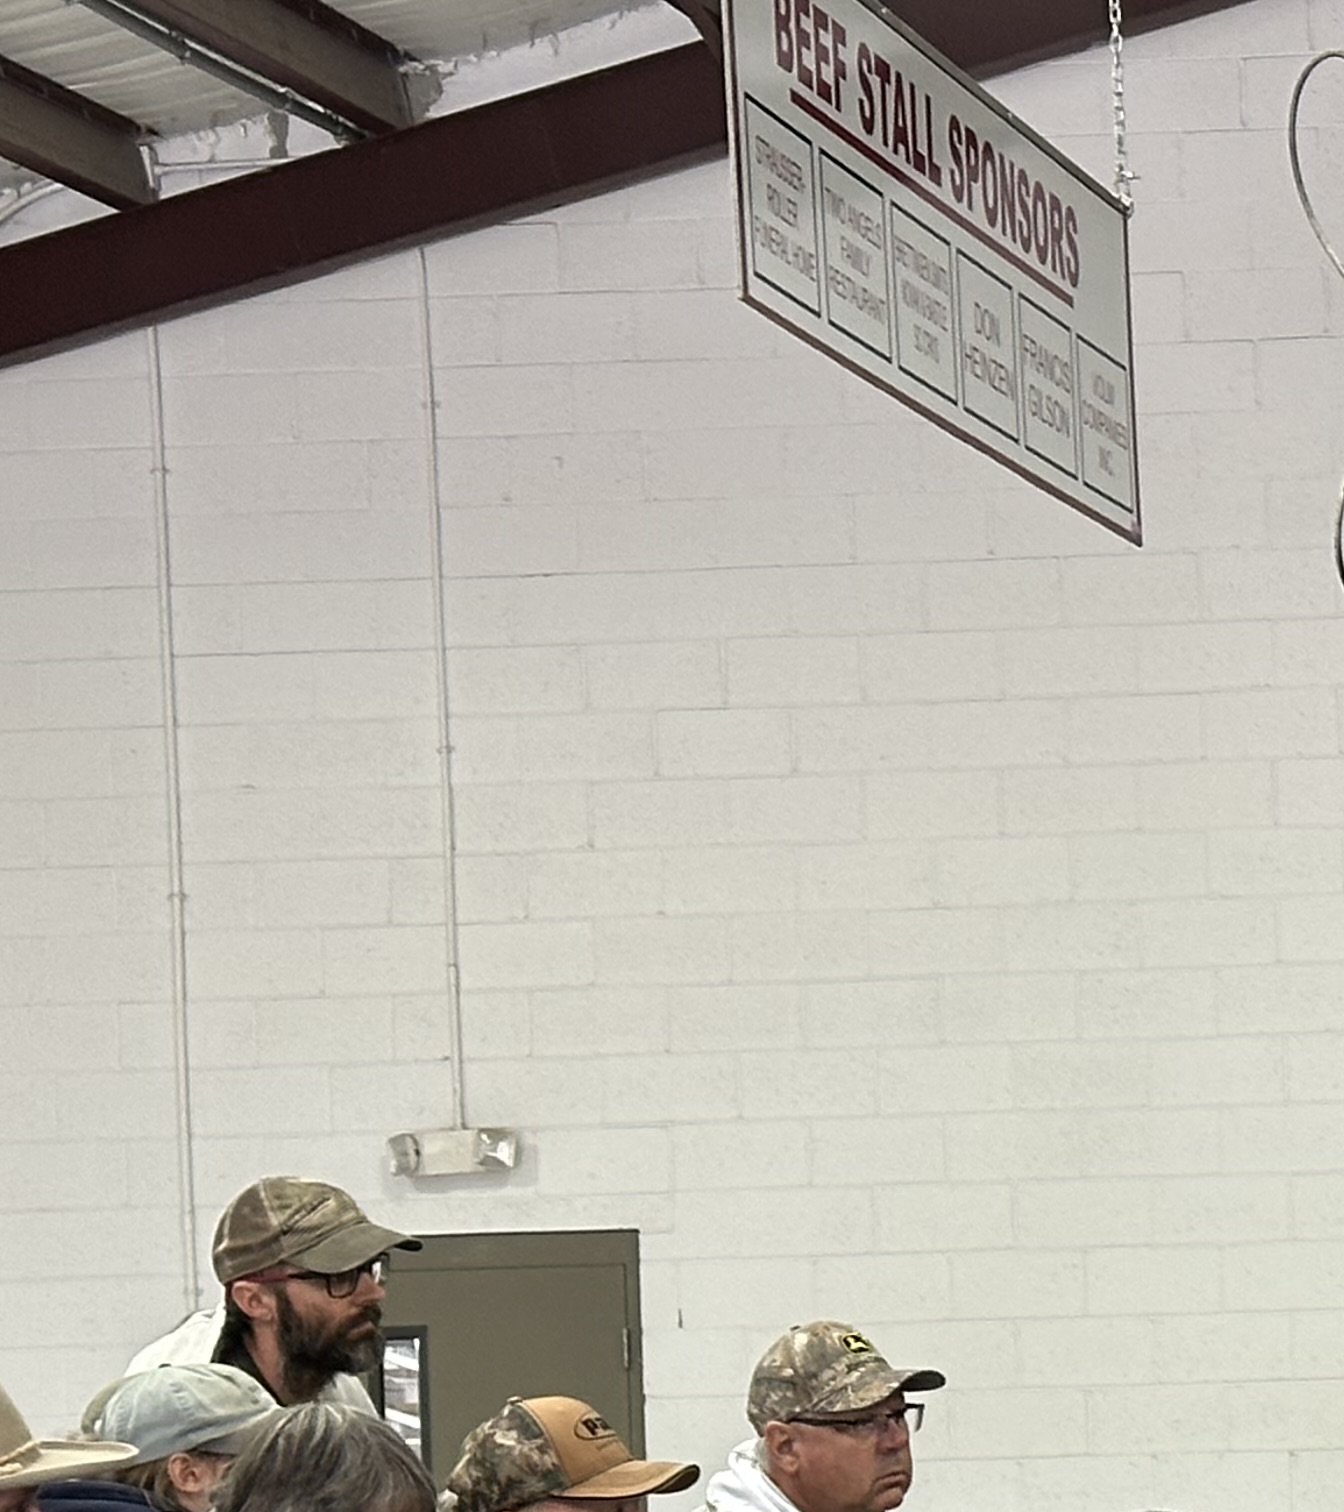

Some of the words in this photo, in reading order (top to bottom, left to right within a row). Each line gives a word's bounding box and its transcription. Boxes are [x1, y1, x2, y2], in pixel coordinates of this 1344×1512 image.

[775, 0, 846, 113] BEEF
[857, 42, 942, 188] STALL
[949, 114, 1080, 289] SPONSORS
